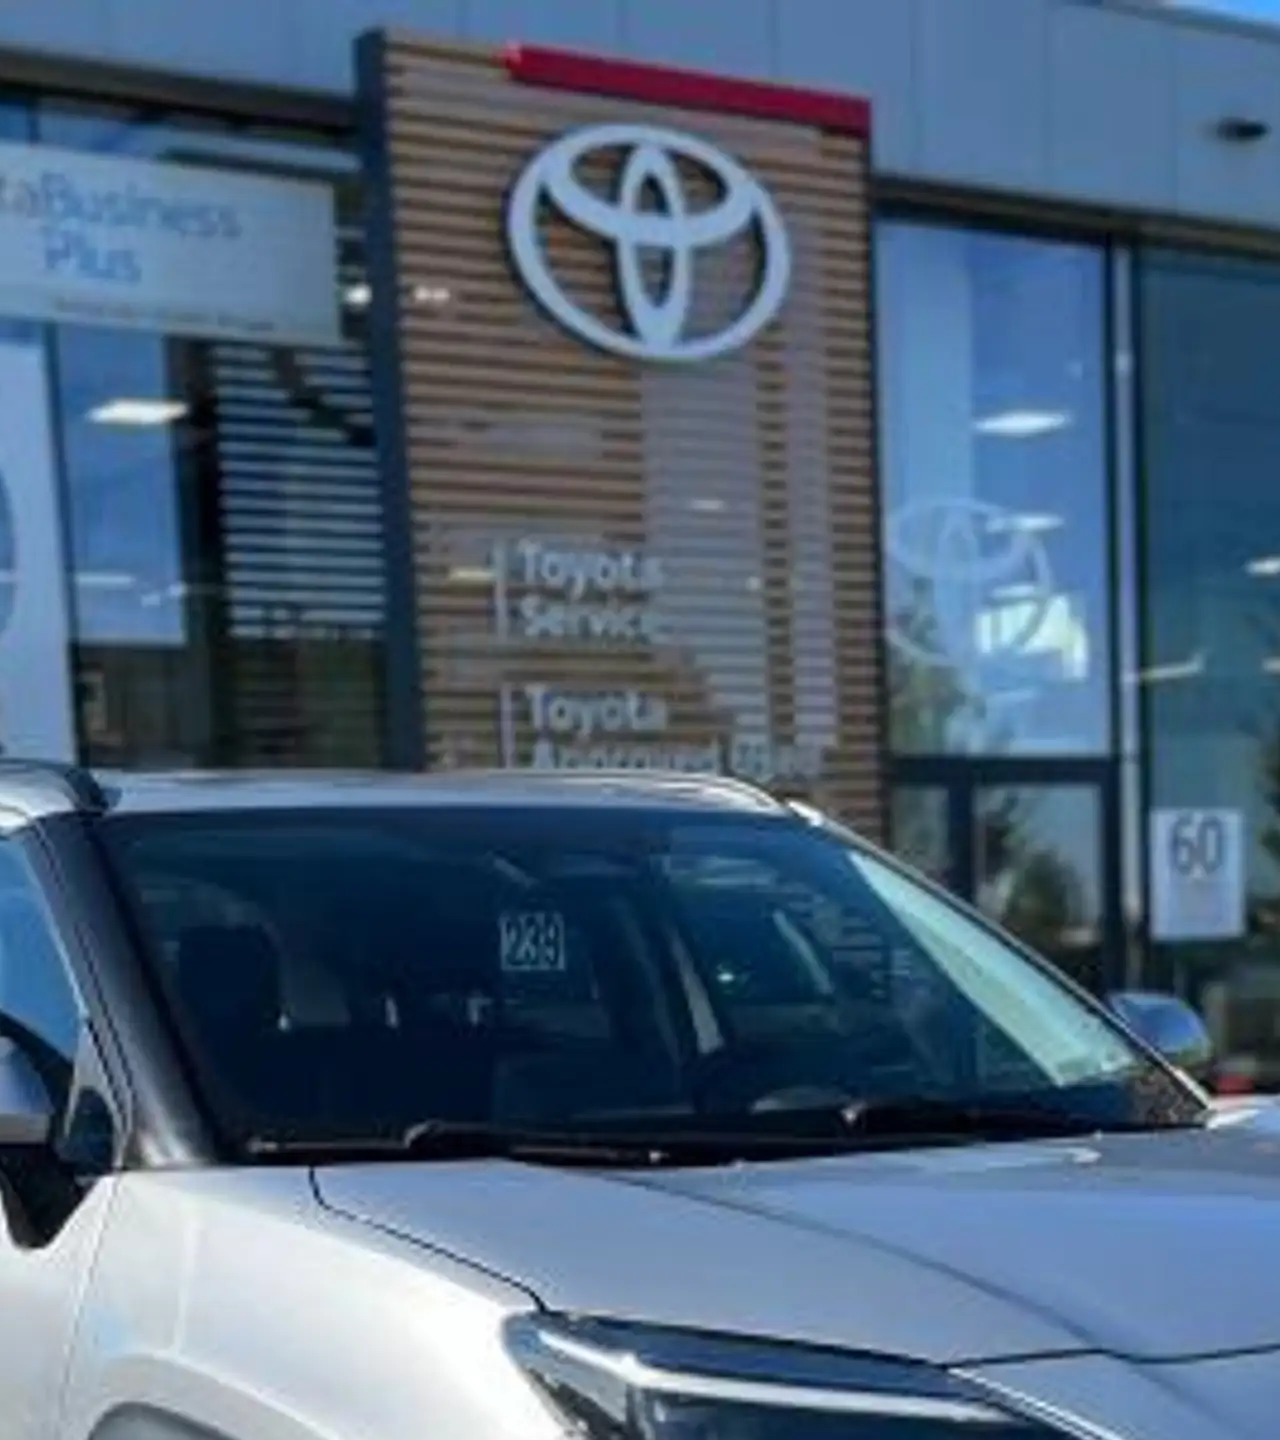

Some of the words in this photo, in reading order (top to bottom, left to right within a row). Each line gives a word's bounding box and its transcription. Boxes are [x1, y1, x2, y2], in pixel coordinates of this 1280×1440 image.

[521, 540, 662, 599] Toyota
[522, 600, 660, 640] Service
[526, 685, 667, 742] Toyota
